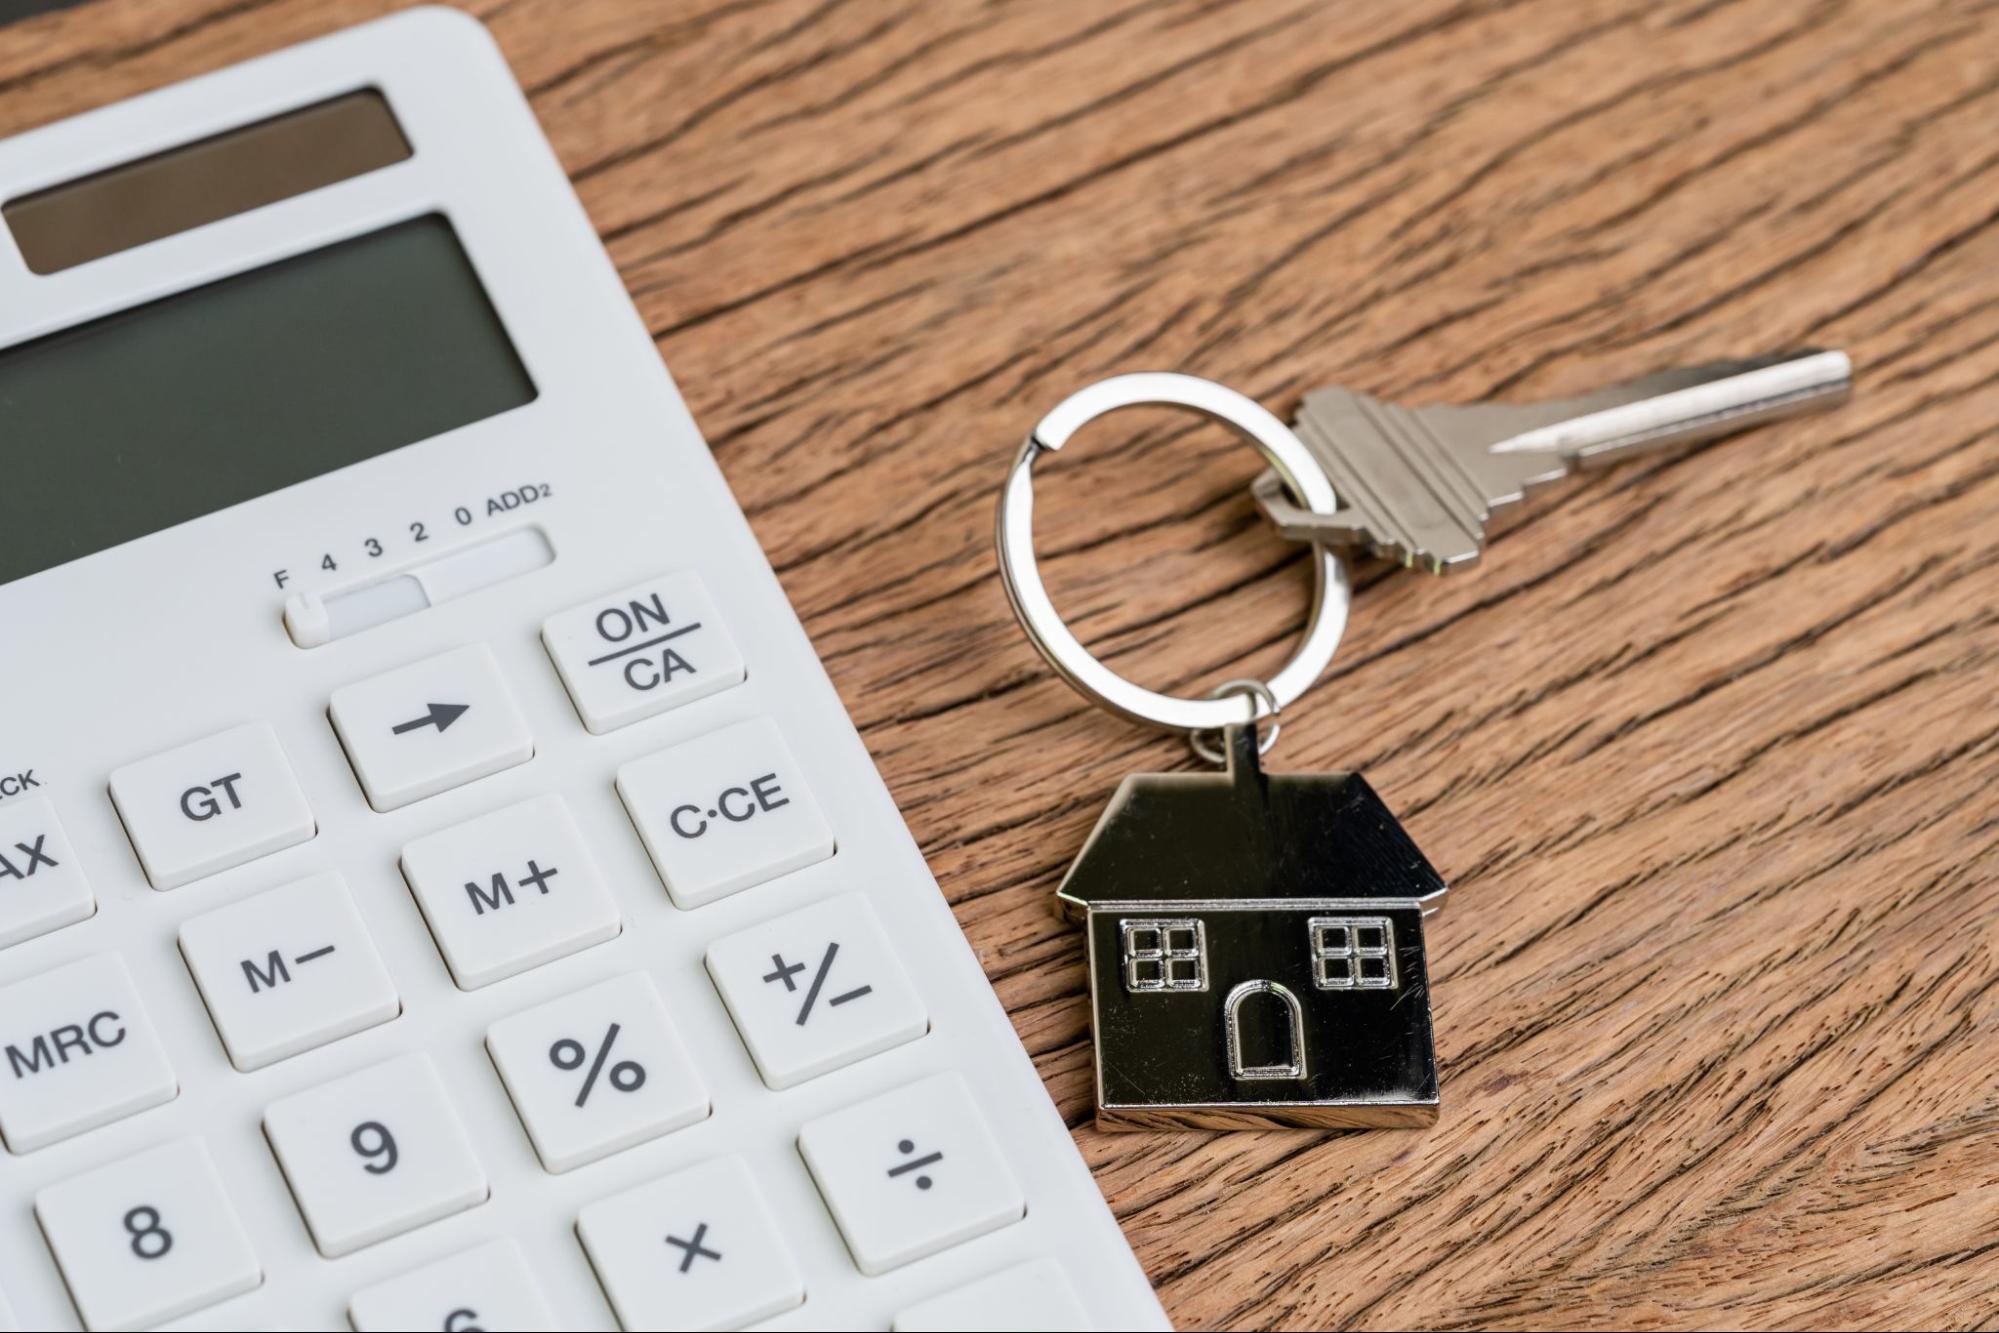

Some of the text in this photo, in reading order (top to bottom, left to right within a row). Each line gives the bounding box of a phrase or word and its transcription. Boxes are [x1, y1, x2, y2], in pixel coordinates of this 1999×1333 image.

[272, 569, 290, 590] F
[320, 553, 338, 572] 4
[363, 537, 384, 558] 3
[409, 521, 429, 543] 2
[595, 593, 671, 643] ON
[623, 648, 697, 691] CA
[0, 769, 41, 799] CK
[179, 772, 242, 822] GT
[464, 859, 558, 916] M+
[4, 1010, 126, 1079] MRC
[548, 1022, 647, 1108] %
[350, 1120, 399, 1175] 9
[122, 1205, 174, 1261] 8
